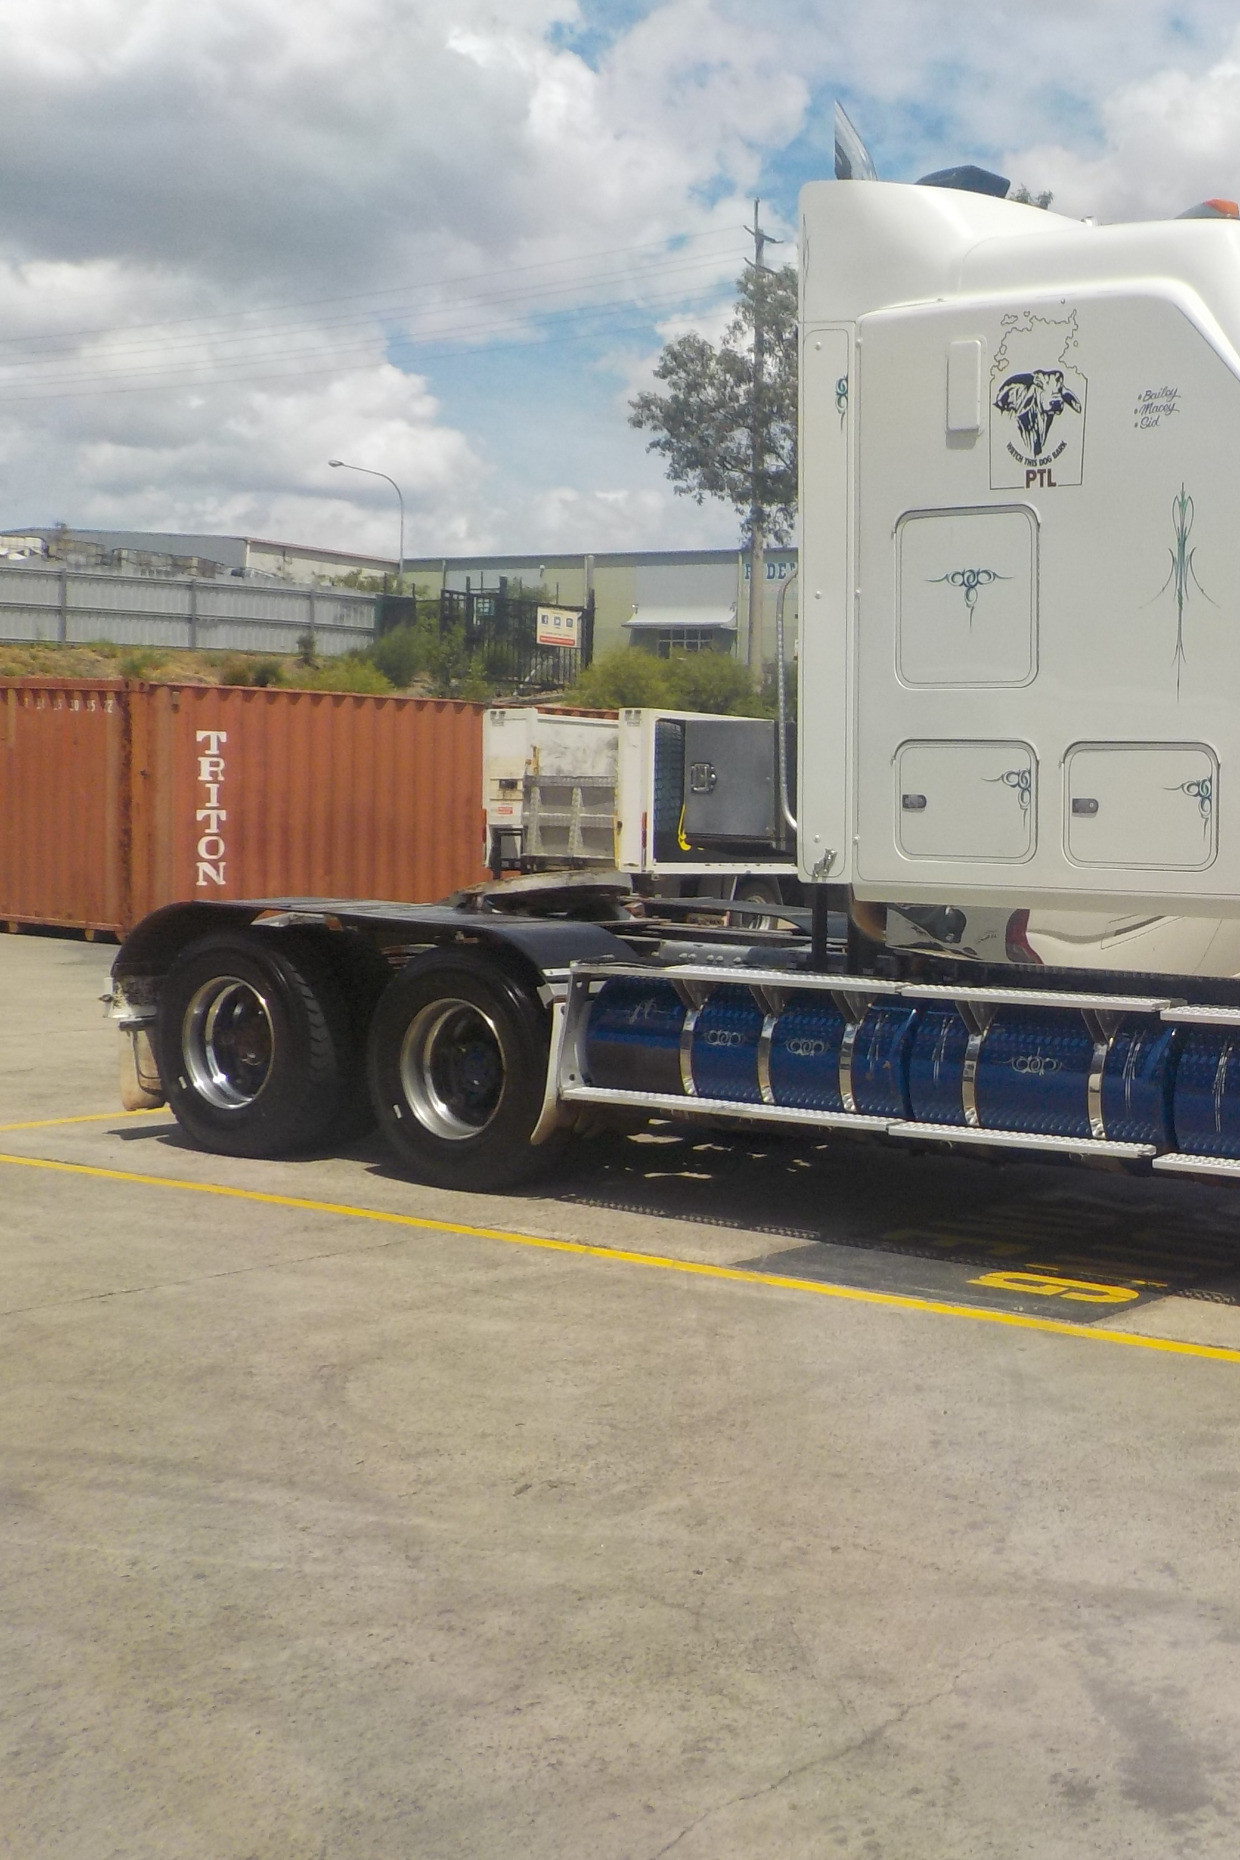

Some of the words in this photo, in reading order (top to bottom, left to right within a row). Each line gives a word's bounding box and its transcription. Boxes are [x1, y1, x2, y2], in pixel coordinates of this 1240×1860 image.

[1142, 386, 1181, 402] Bailey
[1139, 415, 1160, 430] Sid
[1006, 441, 1024, 463] WATCH
[1024, 457, 1038, 467] THIS
[1038, 455, 1052, 466] DOG
[1025, 468, 1057, 488] PTL
[195, 730, 227, 886] TRITON
